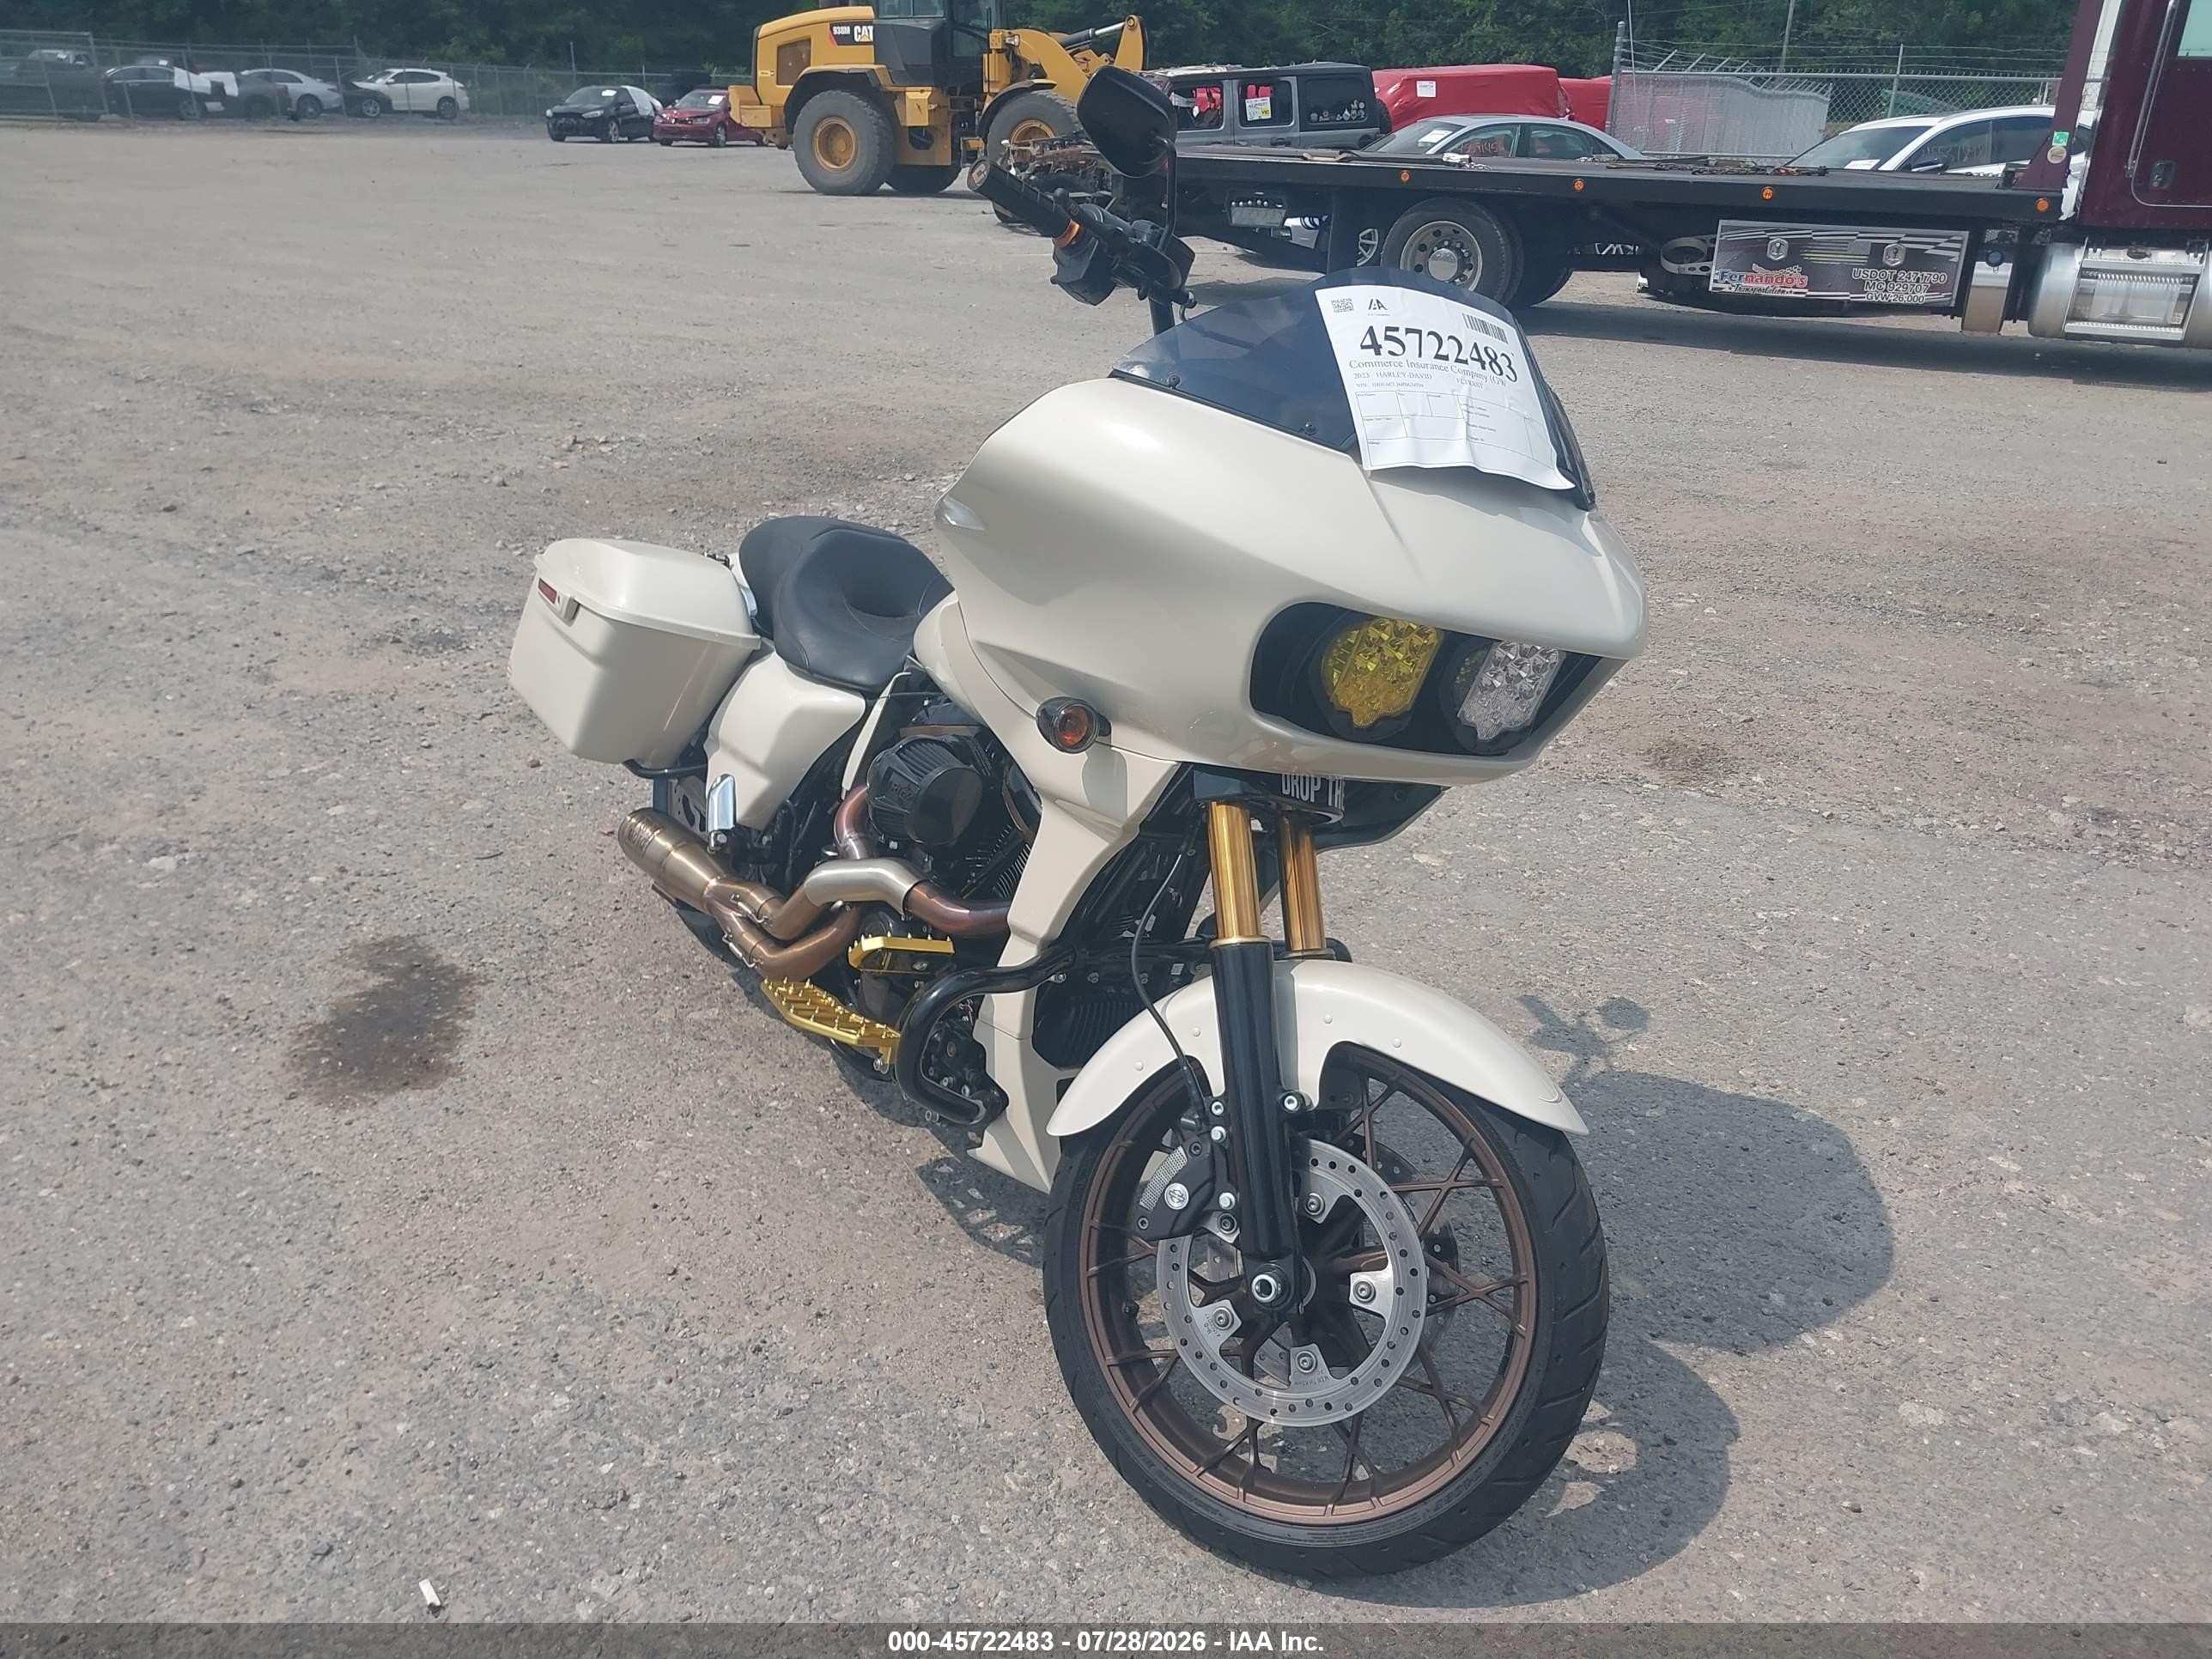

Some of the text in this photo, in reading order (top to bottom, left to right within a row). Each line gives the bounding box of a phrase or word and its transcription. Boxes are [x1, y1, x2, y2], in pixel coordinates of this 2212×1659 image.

[854, 25, 874, 42] CAT
[1718, 268, 1808, 289] Fernando's
[1851, 267, 1948, 284] USDOT 2471790
[1864, 280, 1930, 294] MC 929707
[1865, 292, 1890, 301] GVW
[1359, 325, 1517, 383] 45722483
[1349, 359, 1404, 369] Commerce
[1406, 358, 1449, 373] Insurance
[1450, 364, 1488, 383] Company
